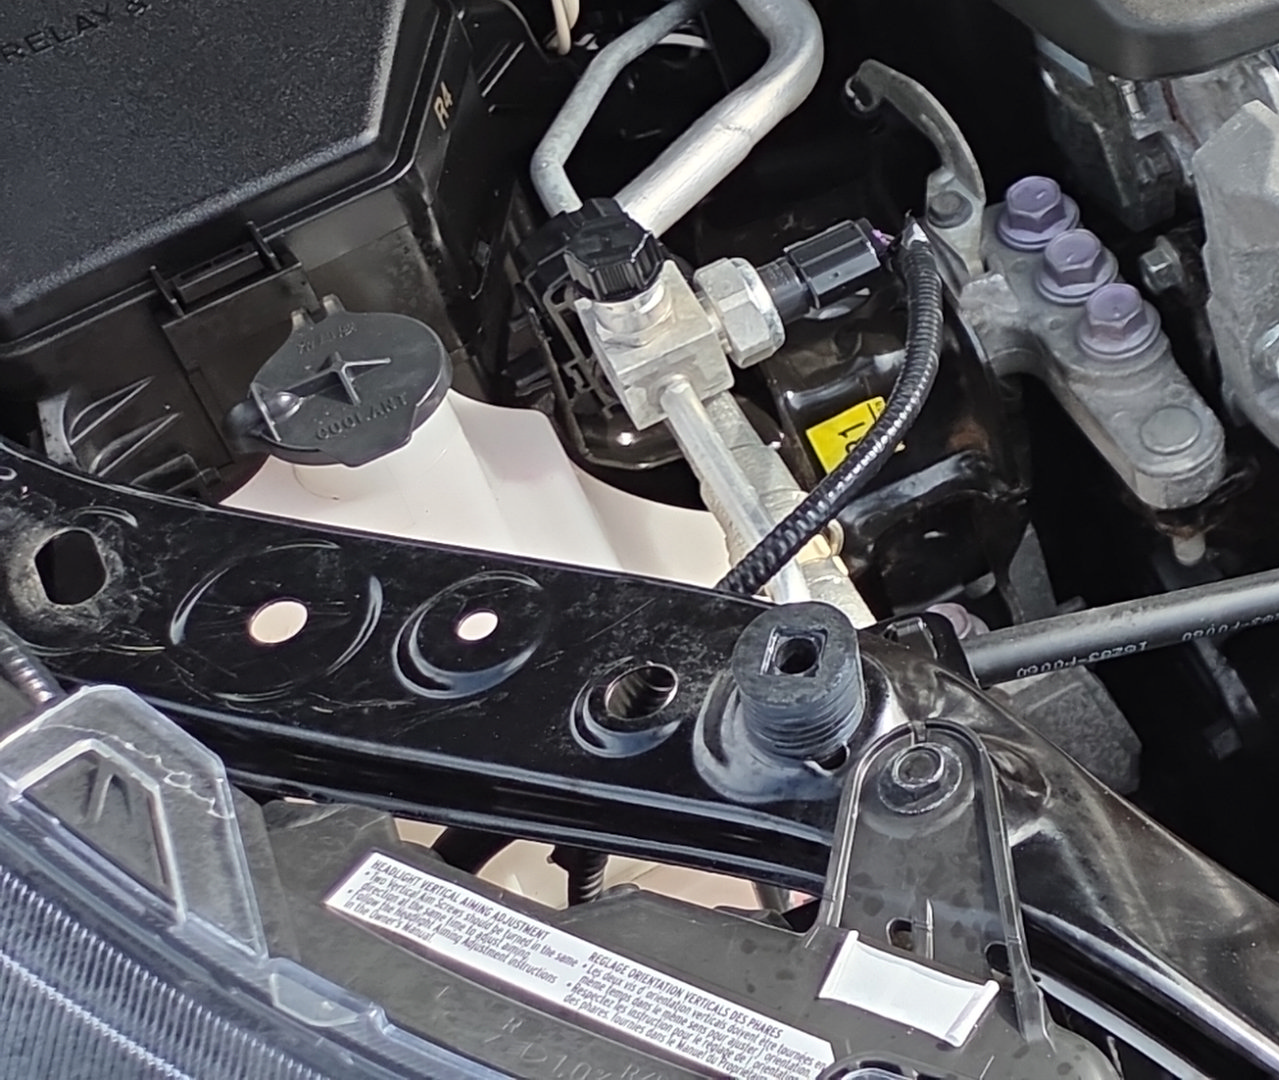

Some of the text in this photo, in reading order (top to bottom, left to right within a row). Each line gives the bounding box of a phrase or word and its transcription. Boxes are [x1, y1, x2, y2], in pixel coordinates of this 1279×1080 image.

[0, 3, 113, 64] RELAY
[434, 81, 455, 130] R4
[315, 391, 410, 441] COOLANT
[344, 898, 354, 908] in
[354, 903, 369, 915] the
[369, 909, 402, 928] Owner's
[352, 889, 384, 906] Follow
[379, 900, 395, 913] the
[432, 924, 463, 944] Aiming
[461, 936, 511, 962] Adjustment
[359, 882, 399, 902] direction
[398, 898, 410, 907] at
[408, 901, 424, 912] the
[422, 908, 447, 922] same
[445, 916, 466, 931] time
[465, 925, 476, 936] to
[475, 932, 504, 947] adjust
[370, 872, 578, 967] Two Vertical Aim Screws should be turned in the same
[371, 860, 550, 940] HEADLIGHT VERTICAL AIMING ADJUSTMENT
[563, 993, 580, 1006] des
[645, 1028, 666, 1042] dans
[666, 1034, 676, 1046] le
[676, 1039, 708, 1059] Manuel
[706, 1052, 718, 1064] du
[571, 982, 617, 1008] Respectez
[613, 1000, 628, 1013] les
[627, 1006, 673, 1032] instruction
[670, 1027, 693, 1043] pour
[692, 1034, 702, 1045] le
[734, 1052, 746, 1063] de
[586, 964, 602, 977] Les
[602, 972, 624, 986] deux
[624, 981, 637, 992] vis
[692, 1010, 727, 1029] verticals
[727, 1024, 760, 1043] doivent
[588, 952, 783, 1039] REGLAGE ORIENTATION VERTICALS DES PHARES
[605, 983, 632, 1002] temps
[631, 997, 653, 1012] dans
[652, 1005, 662, 1015] le
[662, 1007, 688, 1026] même
[687, 1021, 707, 1034] sens
[706, 1030, 729, 1045] pour
[727, 1037, 758, 1058] ajuster
